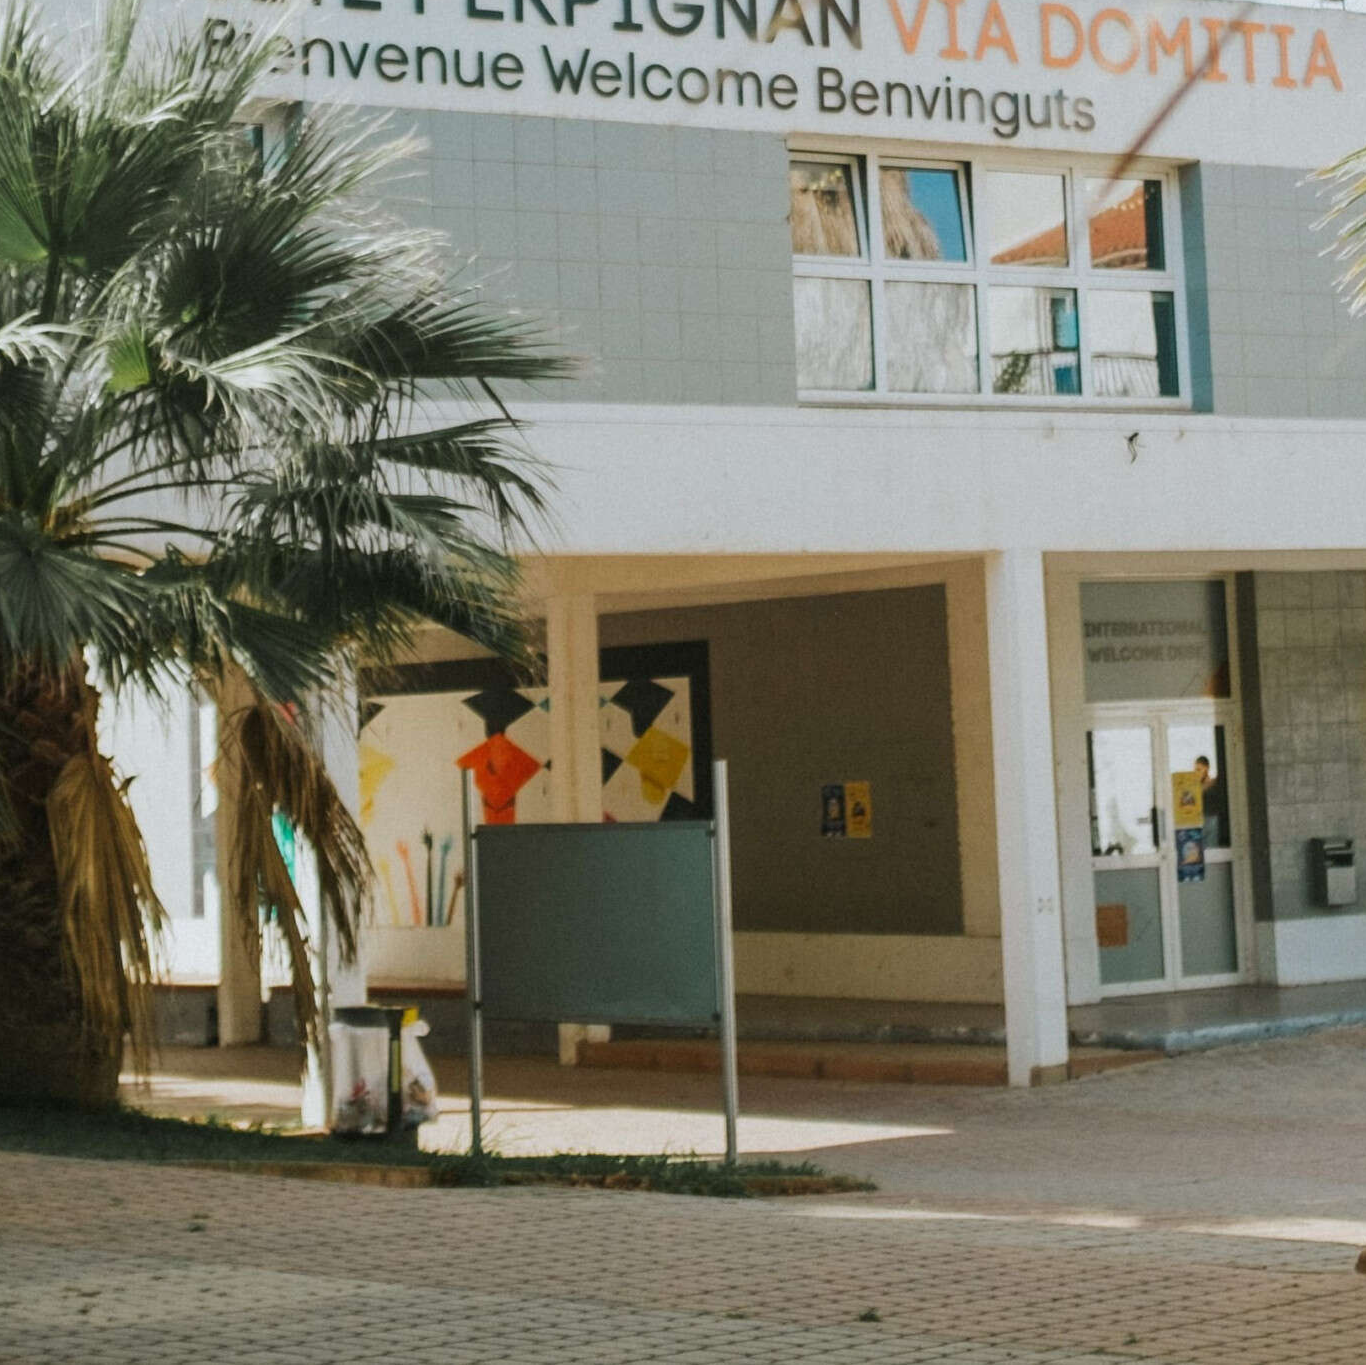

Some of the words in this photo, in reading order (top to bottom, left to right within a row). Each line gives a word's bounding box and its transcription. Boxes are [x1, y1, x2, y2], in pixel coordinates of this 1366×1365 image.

[541, 43, 799, 111] Welcome
[816, 66, 1098, 139] Benvinguts
[1039, 1, 1345, 92] DOMITIA
